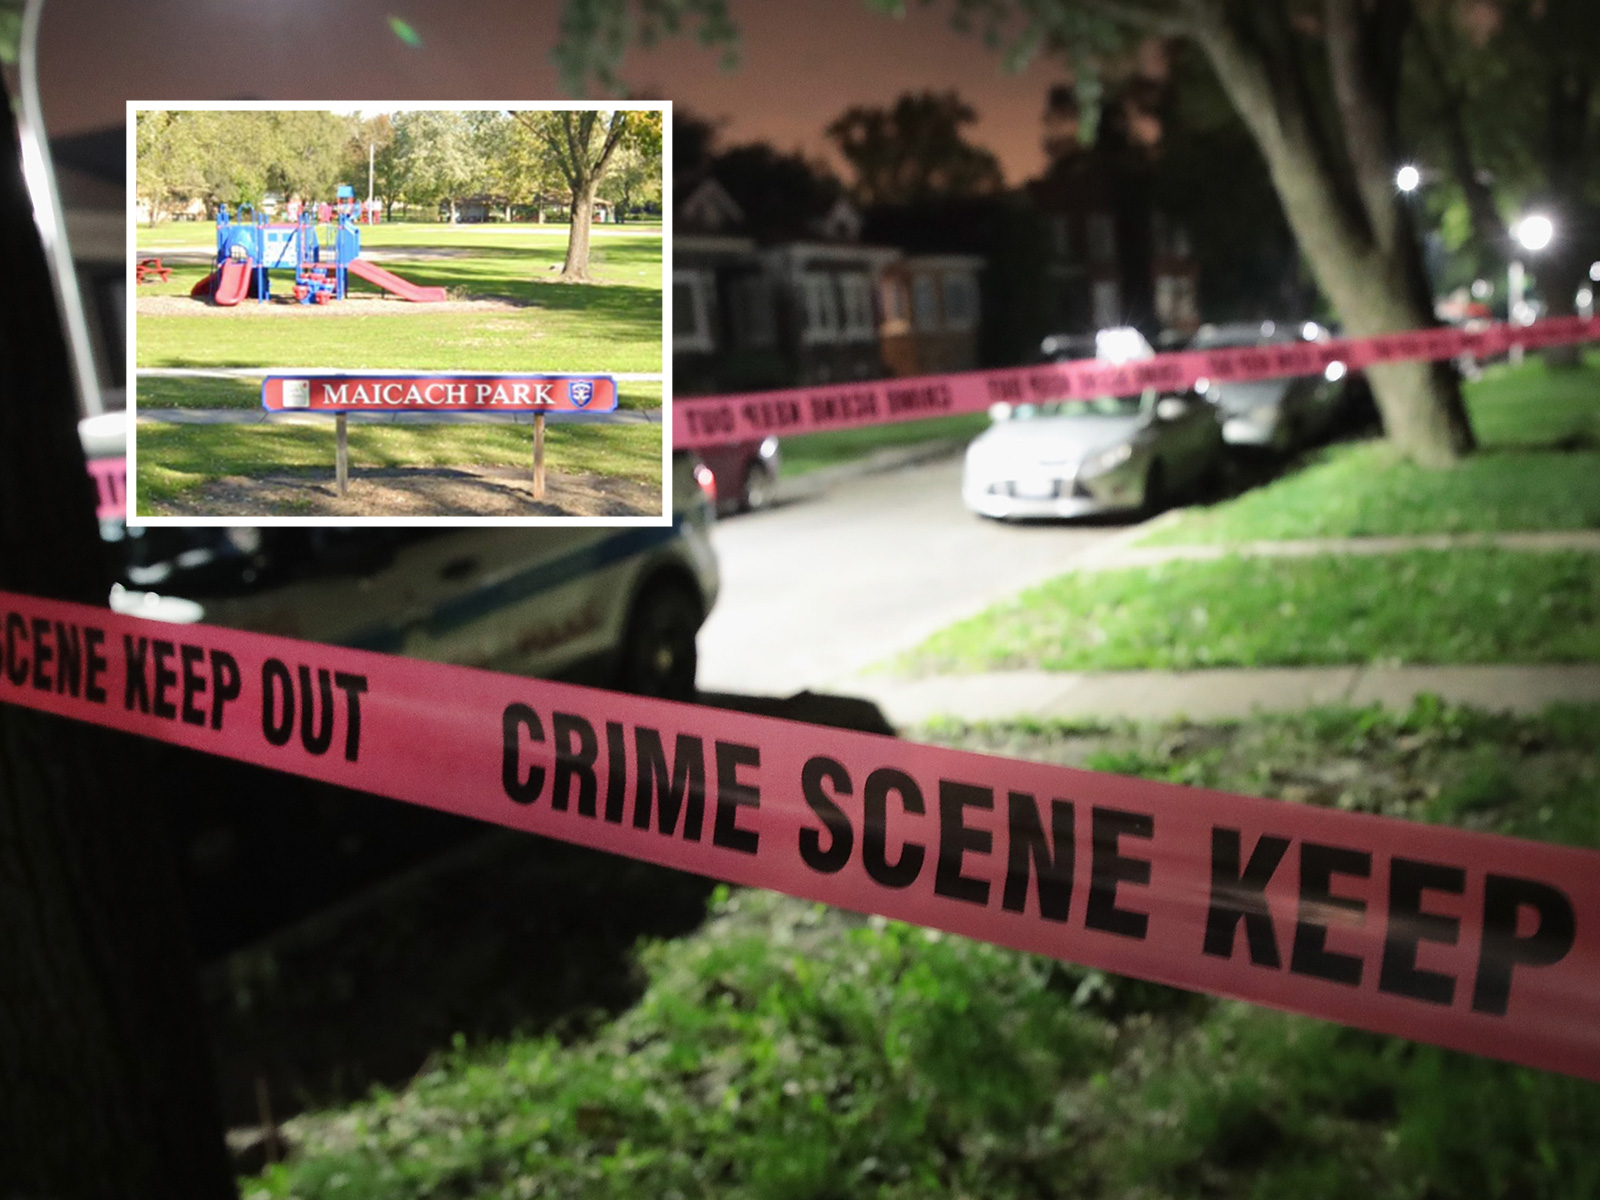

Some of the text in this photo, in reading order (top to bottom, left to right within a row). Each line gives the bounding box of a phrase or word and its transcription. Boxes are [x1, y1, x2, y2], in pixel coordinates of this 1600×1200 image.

[322, 383, 556, 405] MAICACH PARK
[0, 611, 1578, 1018] CENE KEEP OUT CRIME SCENE KEEP
